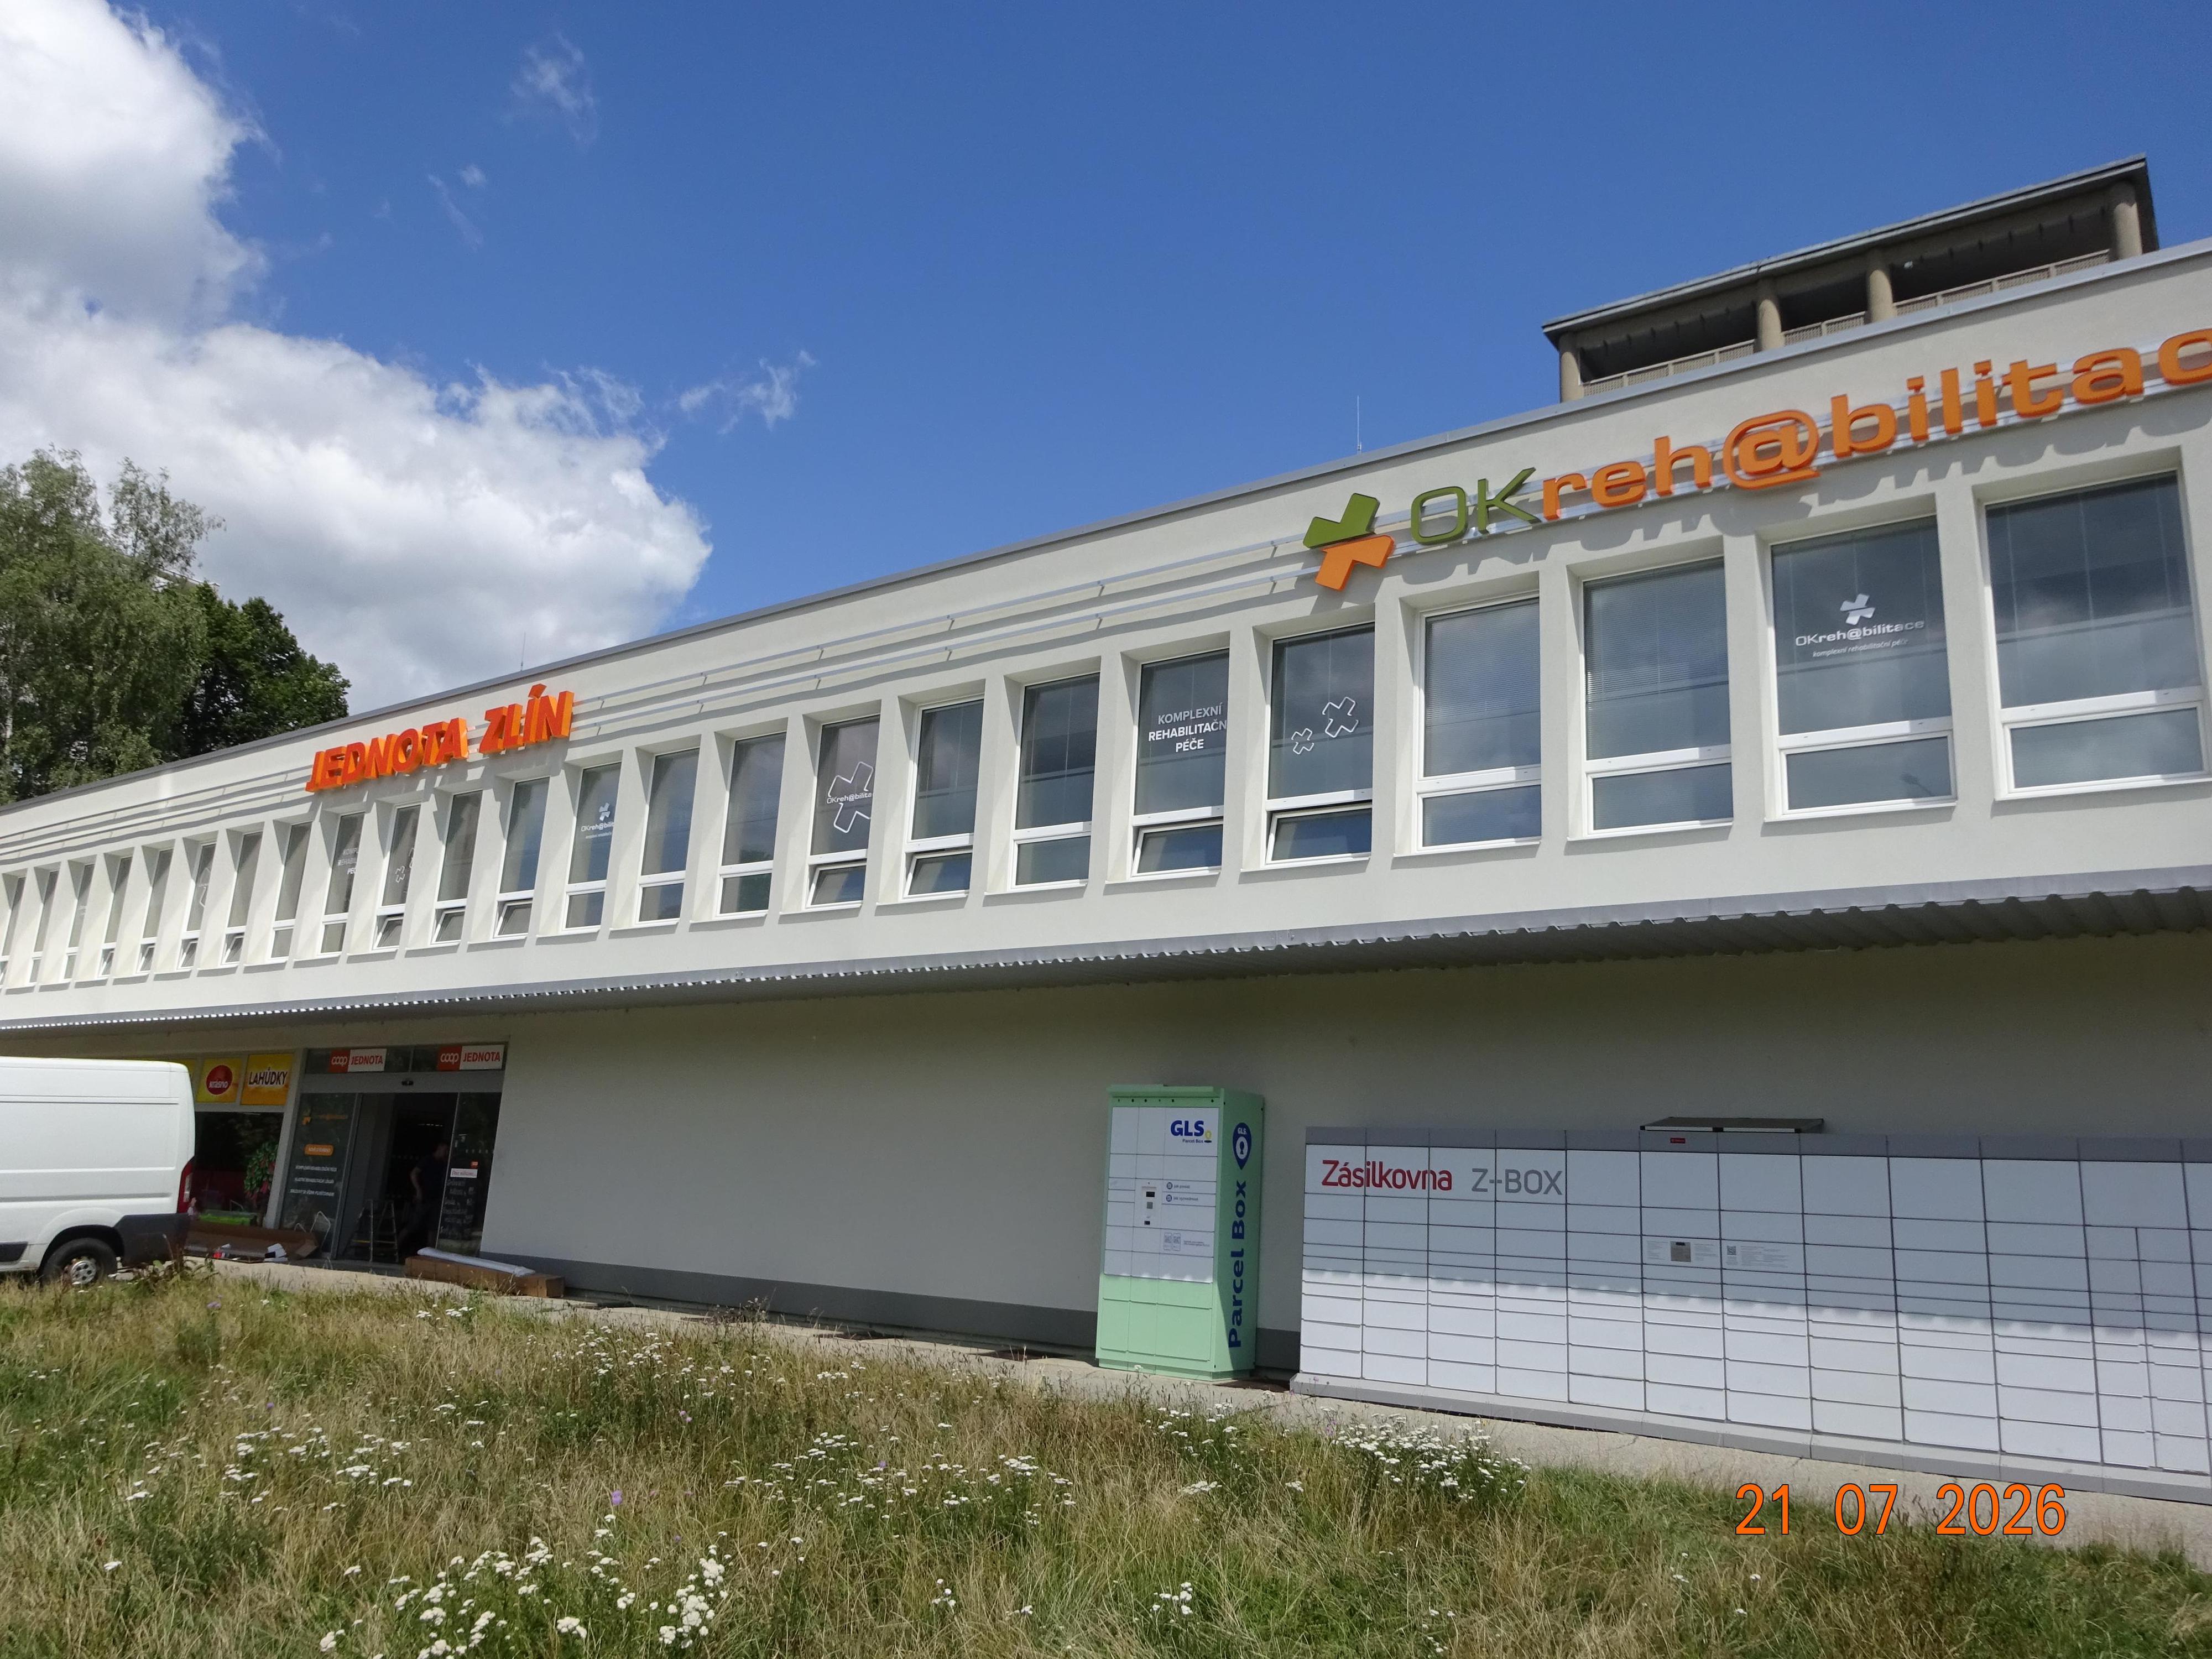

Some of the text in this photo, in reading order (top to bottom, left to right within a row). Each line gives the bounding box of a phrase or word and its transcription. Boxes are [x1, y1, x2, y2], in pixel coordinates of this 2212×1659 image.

[1796, 620, 1924, 646] OKreh@bilitace
[1158, 702, 1223, 725] KOMPLEXNÍ
[305, 683, 574, 792] JEDNOTA ZLÍN
[1176, 737, 1204, 753] PÉČE
[351, 1055, 384, 1066] JEDNOTA
[463, 1051, 501, 1062] JEDNOTA
[249, 1067, 288, 1086] LAHŮDKY
[1171, 1120, 1204, 1136] GLS
[1321, 1160, 1563, 1196] Zásilkovna Z-BOX
[1228, 1180, 1246, 1348] Parcel Box
